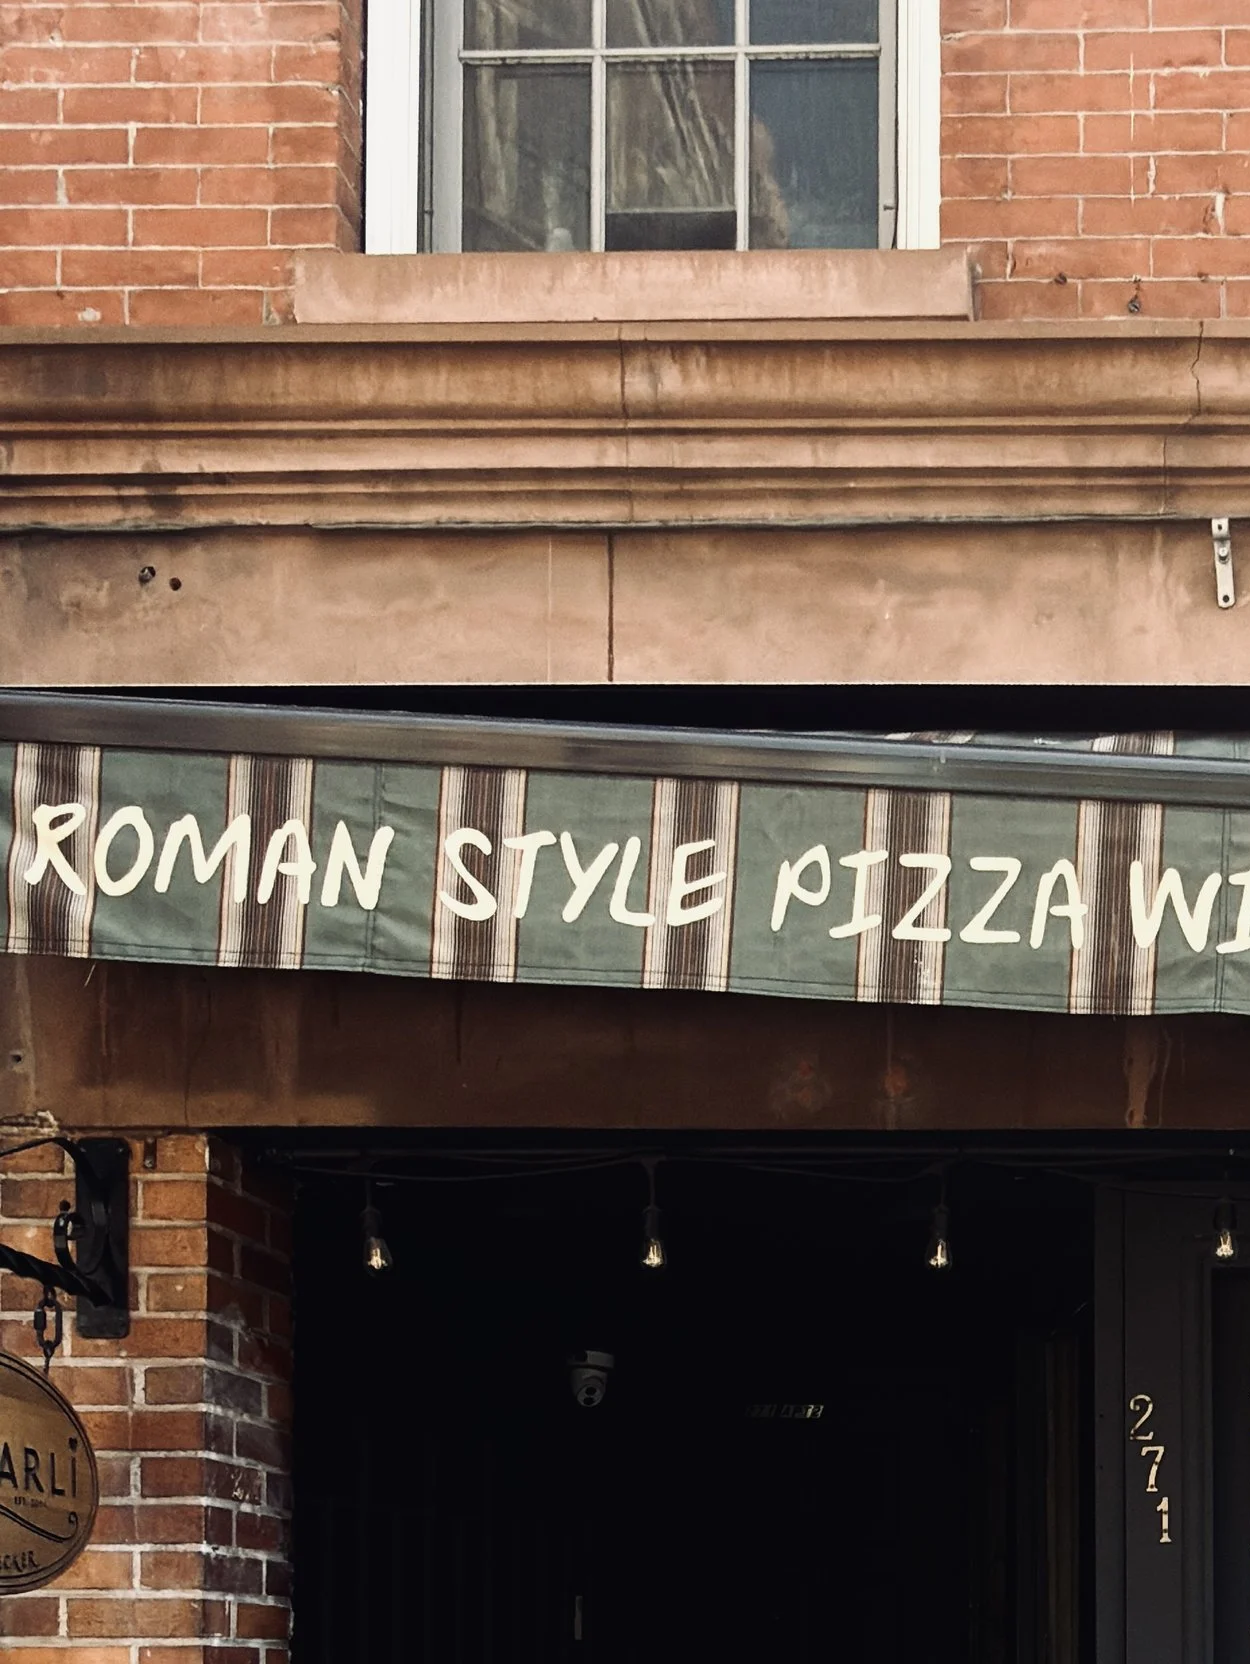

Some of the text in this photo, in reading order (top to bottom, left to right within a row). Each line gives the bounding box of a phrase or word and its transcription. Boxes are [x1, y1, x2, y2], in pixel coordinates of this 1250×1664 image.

[24, 802, 394, 910] ROMAN
[440, 827, 726, 927] STYLE
[771, 845, 1088, 950] PIZZA
[1129, 1394, 1173, 1543] 271
